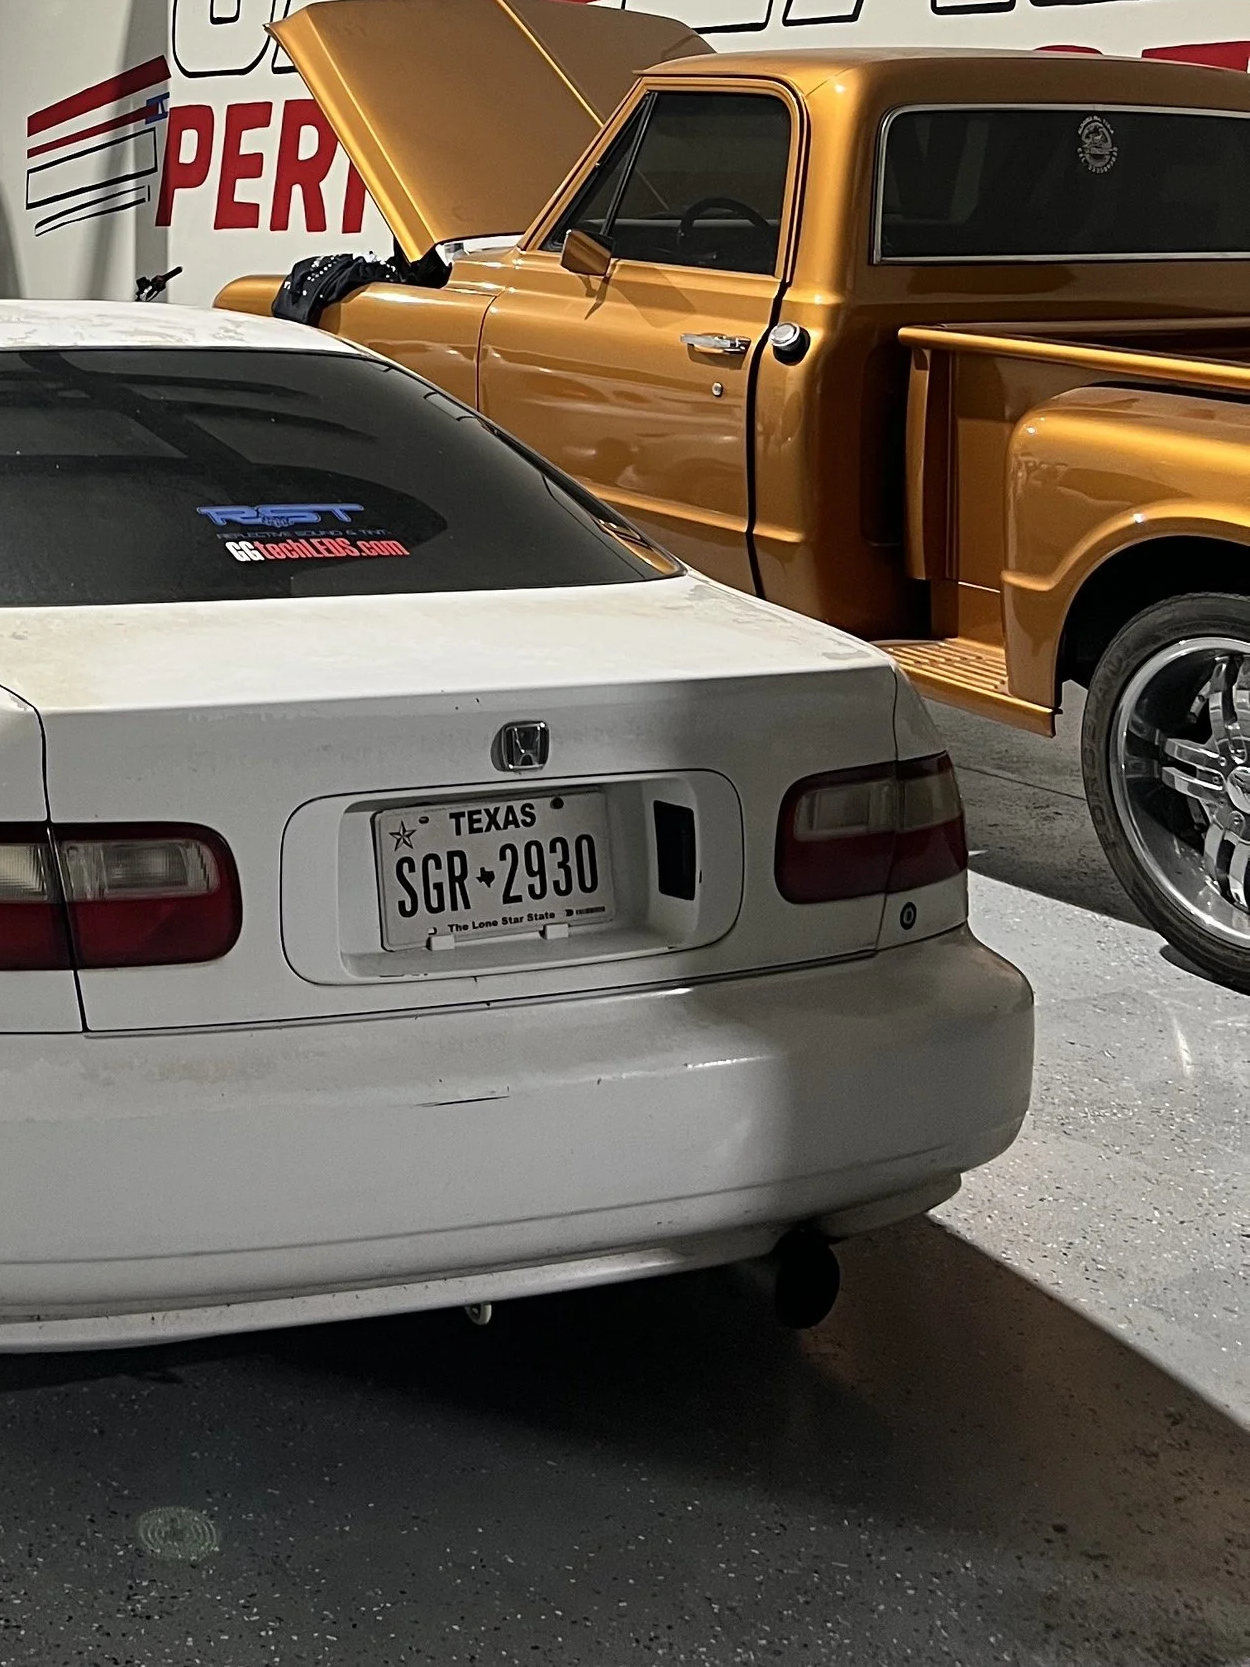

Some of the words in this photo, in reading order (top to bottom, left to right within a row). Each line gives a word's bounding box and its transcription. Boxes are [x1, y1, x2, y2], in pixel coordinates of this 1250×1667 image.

[449, 802, 537, 836] TEXAS
[395, 850, 472, 918] SGR
[499, 834, 599, 905] 2930
[447, 922, 469, 934] The
[471, 918, 499, 930] Lone
[501, 914, 524, 926] Star
[526, 911, 556, 923] State
